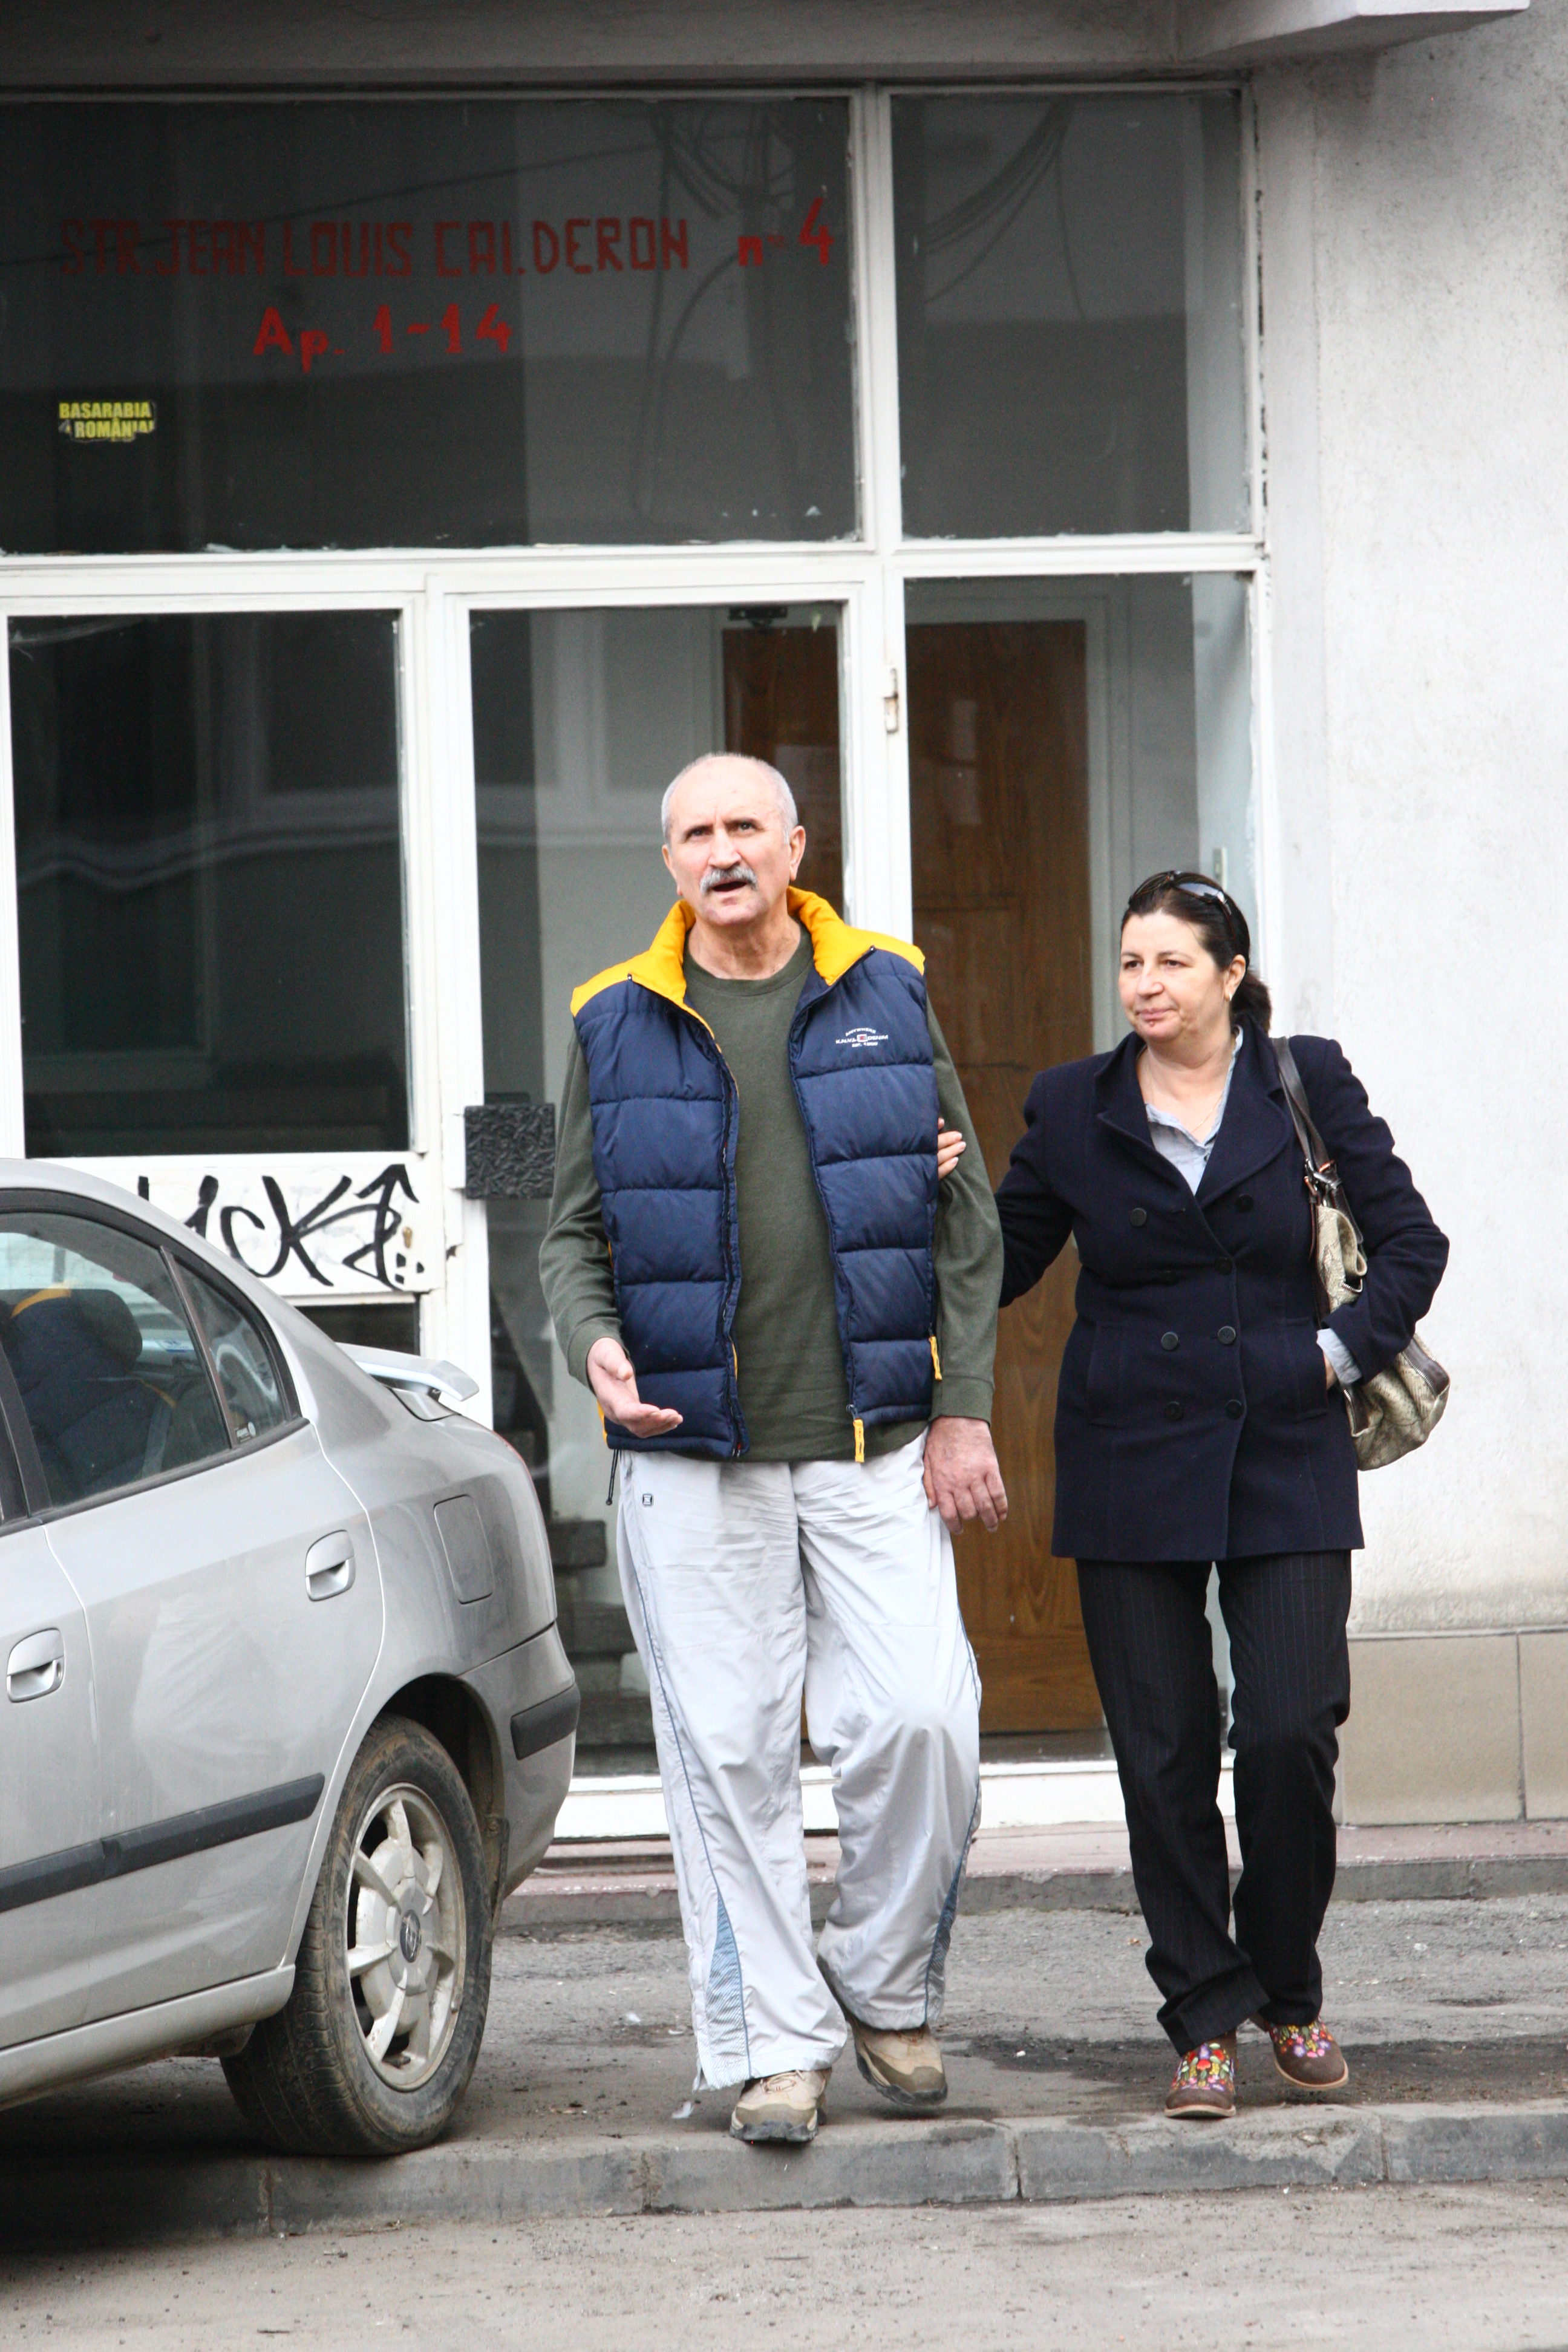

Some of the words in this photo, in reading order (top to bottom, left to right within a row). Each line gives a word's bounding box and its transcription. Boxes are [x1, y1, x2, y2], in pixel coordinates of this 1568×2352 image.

[283, 220, 415, 277] LOUIS
[434, 217, 690, 277] CALDERON
[799, 197, 835, 266] 4
[252, 306, 345, 373] Ap.
[59, 402, 151, 418] BASARABIA
